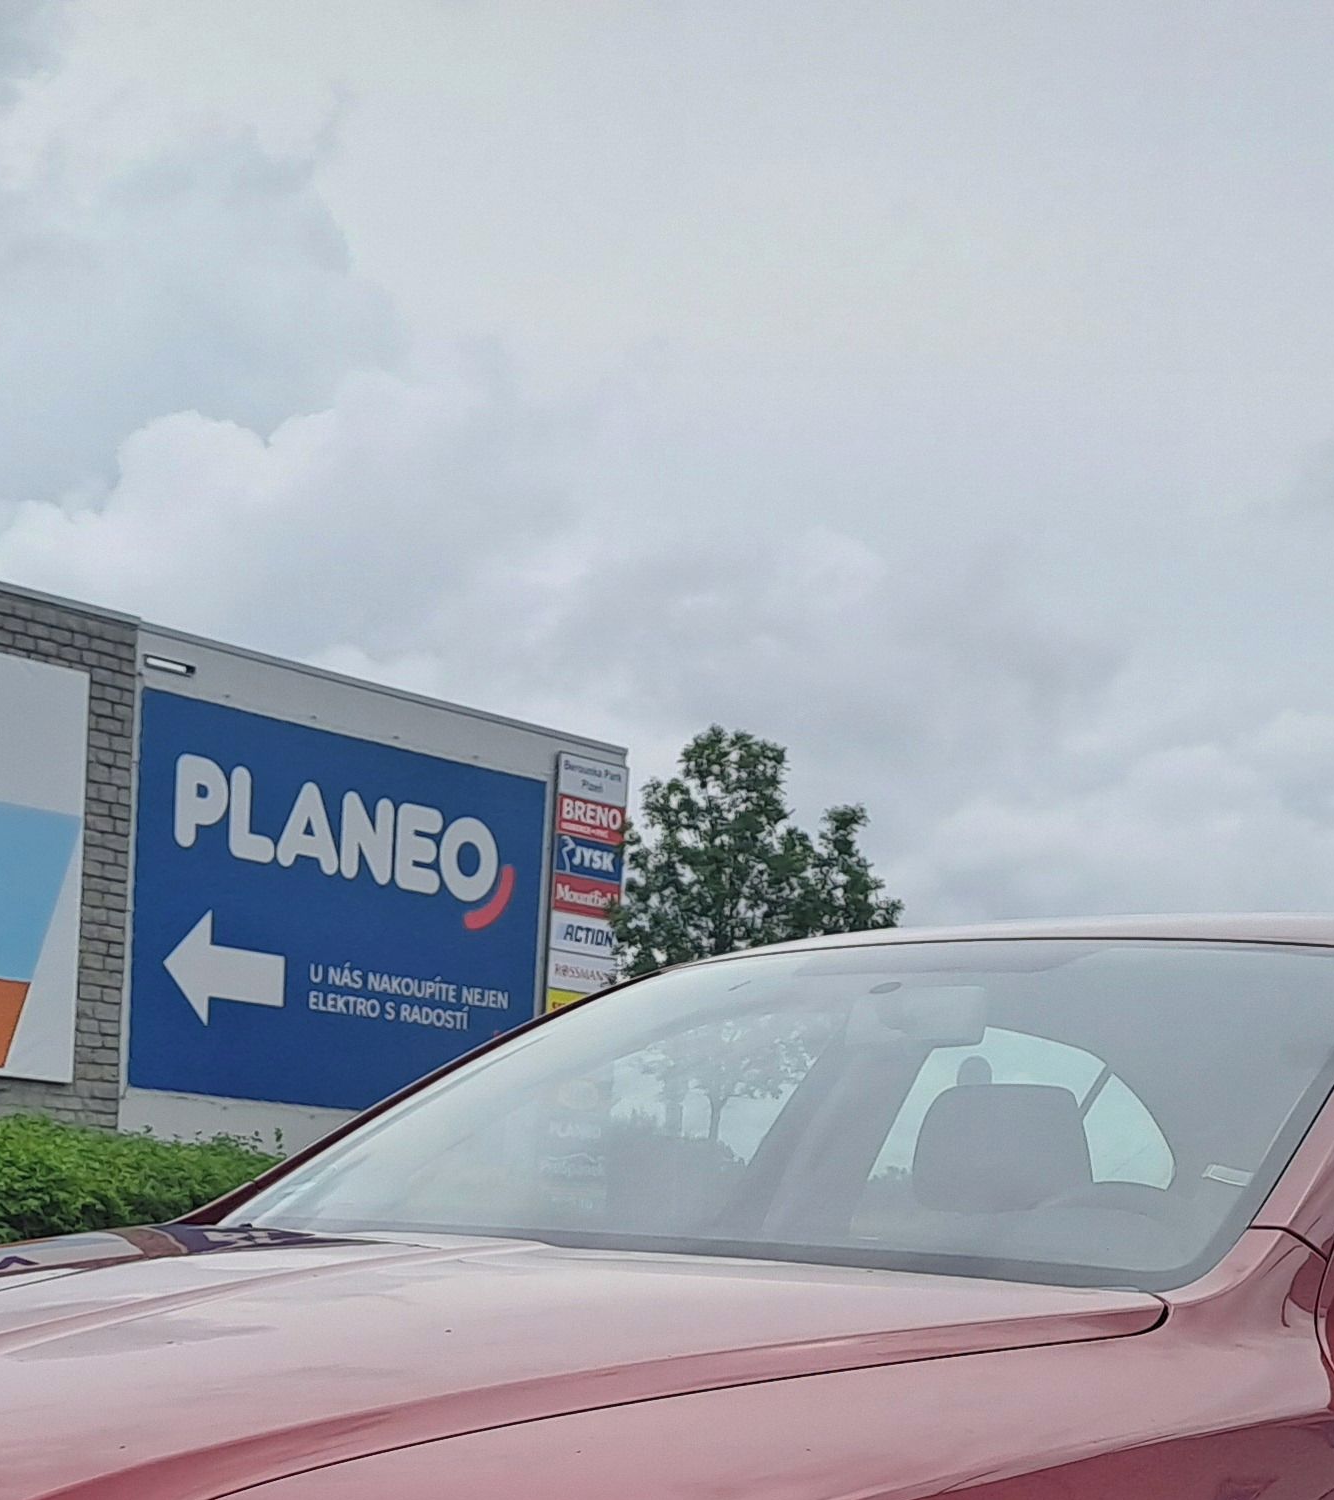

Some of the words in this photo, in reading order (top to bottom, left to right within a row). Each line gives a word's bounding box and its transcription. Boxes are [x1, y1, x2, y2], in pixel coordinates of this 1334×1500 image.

[174, 753, 498, 902] PLANEO
[562, 797, 622, 830] BRENO
[571, 844, 615, 873] JYSK
[563, 924, 615, 948] ACTION
[309, 963, 323, 983] U
[328, 962, 363, 989] NÁS
[367, 970, 457, 1003] NAKOUPÍTE
[461, 985, 509, 1009] NEJEN
[308, 991, 381, 1019] ELEKTRO
[384, 1001, 396, 1020] S
[399, 1004, 469, 1031] RADOSTÍ
